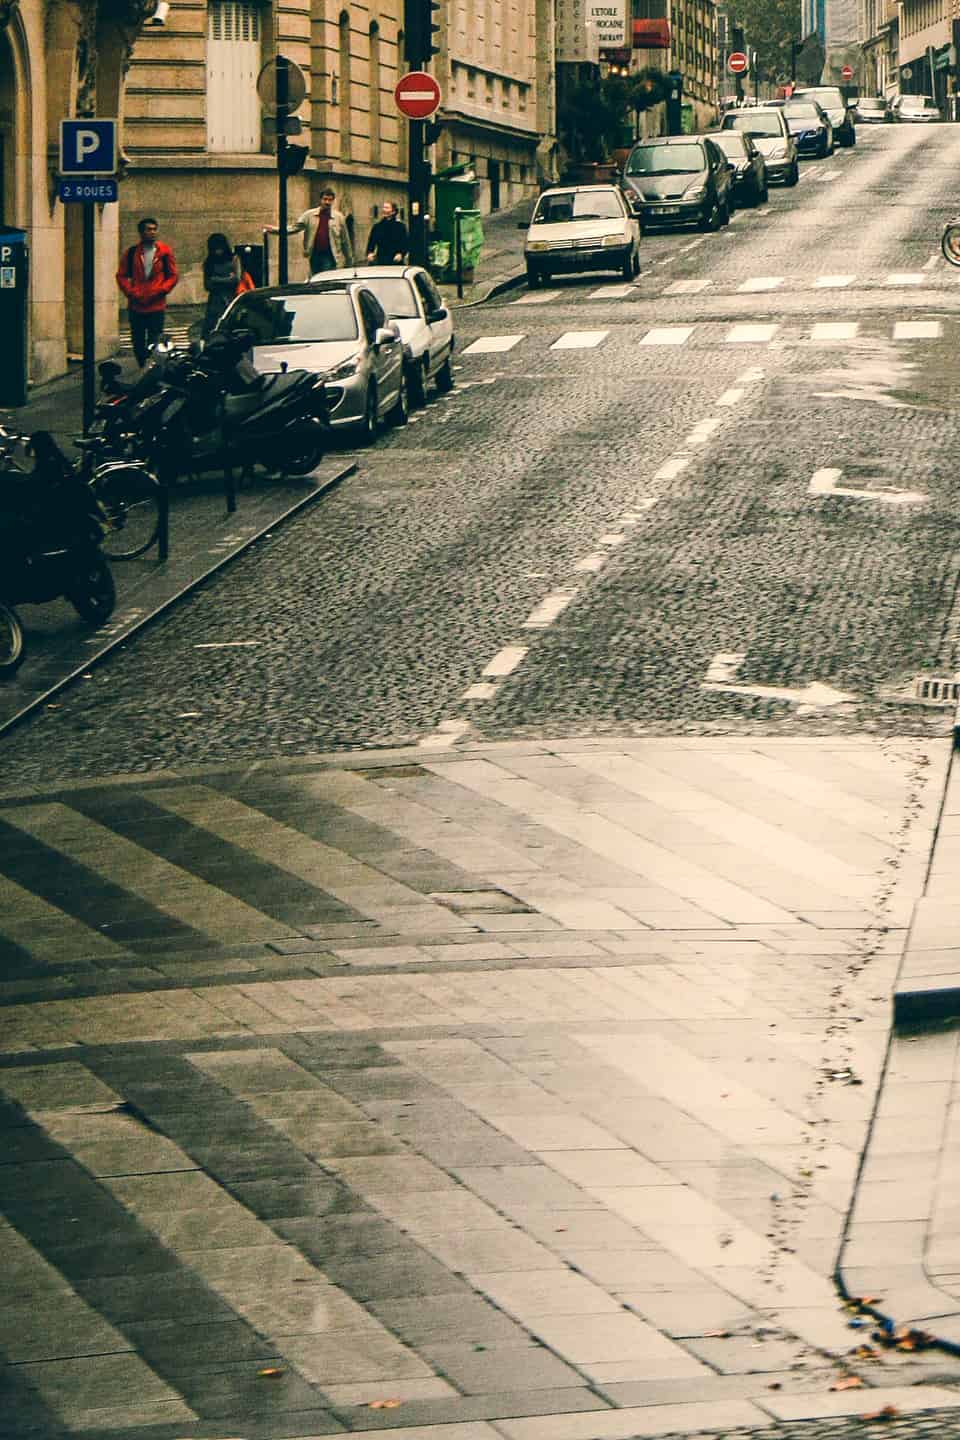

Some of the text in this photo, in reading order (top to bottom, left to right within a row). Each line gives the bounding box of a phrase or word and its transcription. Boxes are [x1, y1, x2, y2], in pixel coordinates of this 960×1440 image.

[76, 130, 100, 163] P
[63, 185, 113, 197] 2 ROUES
